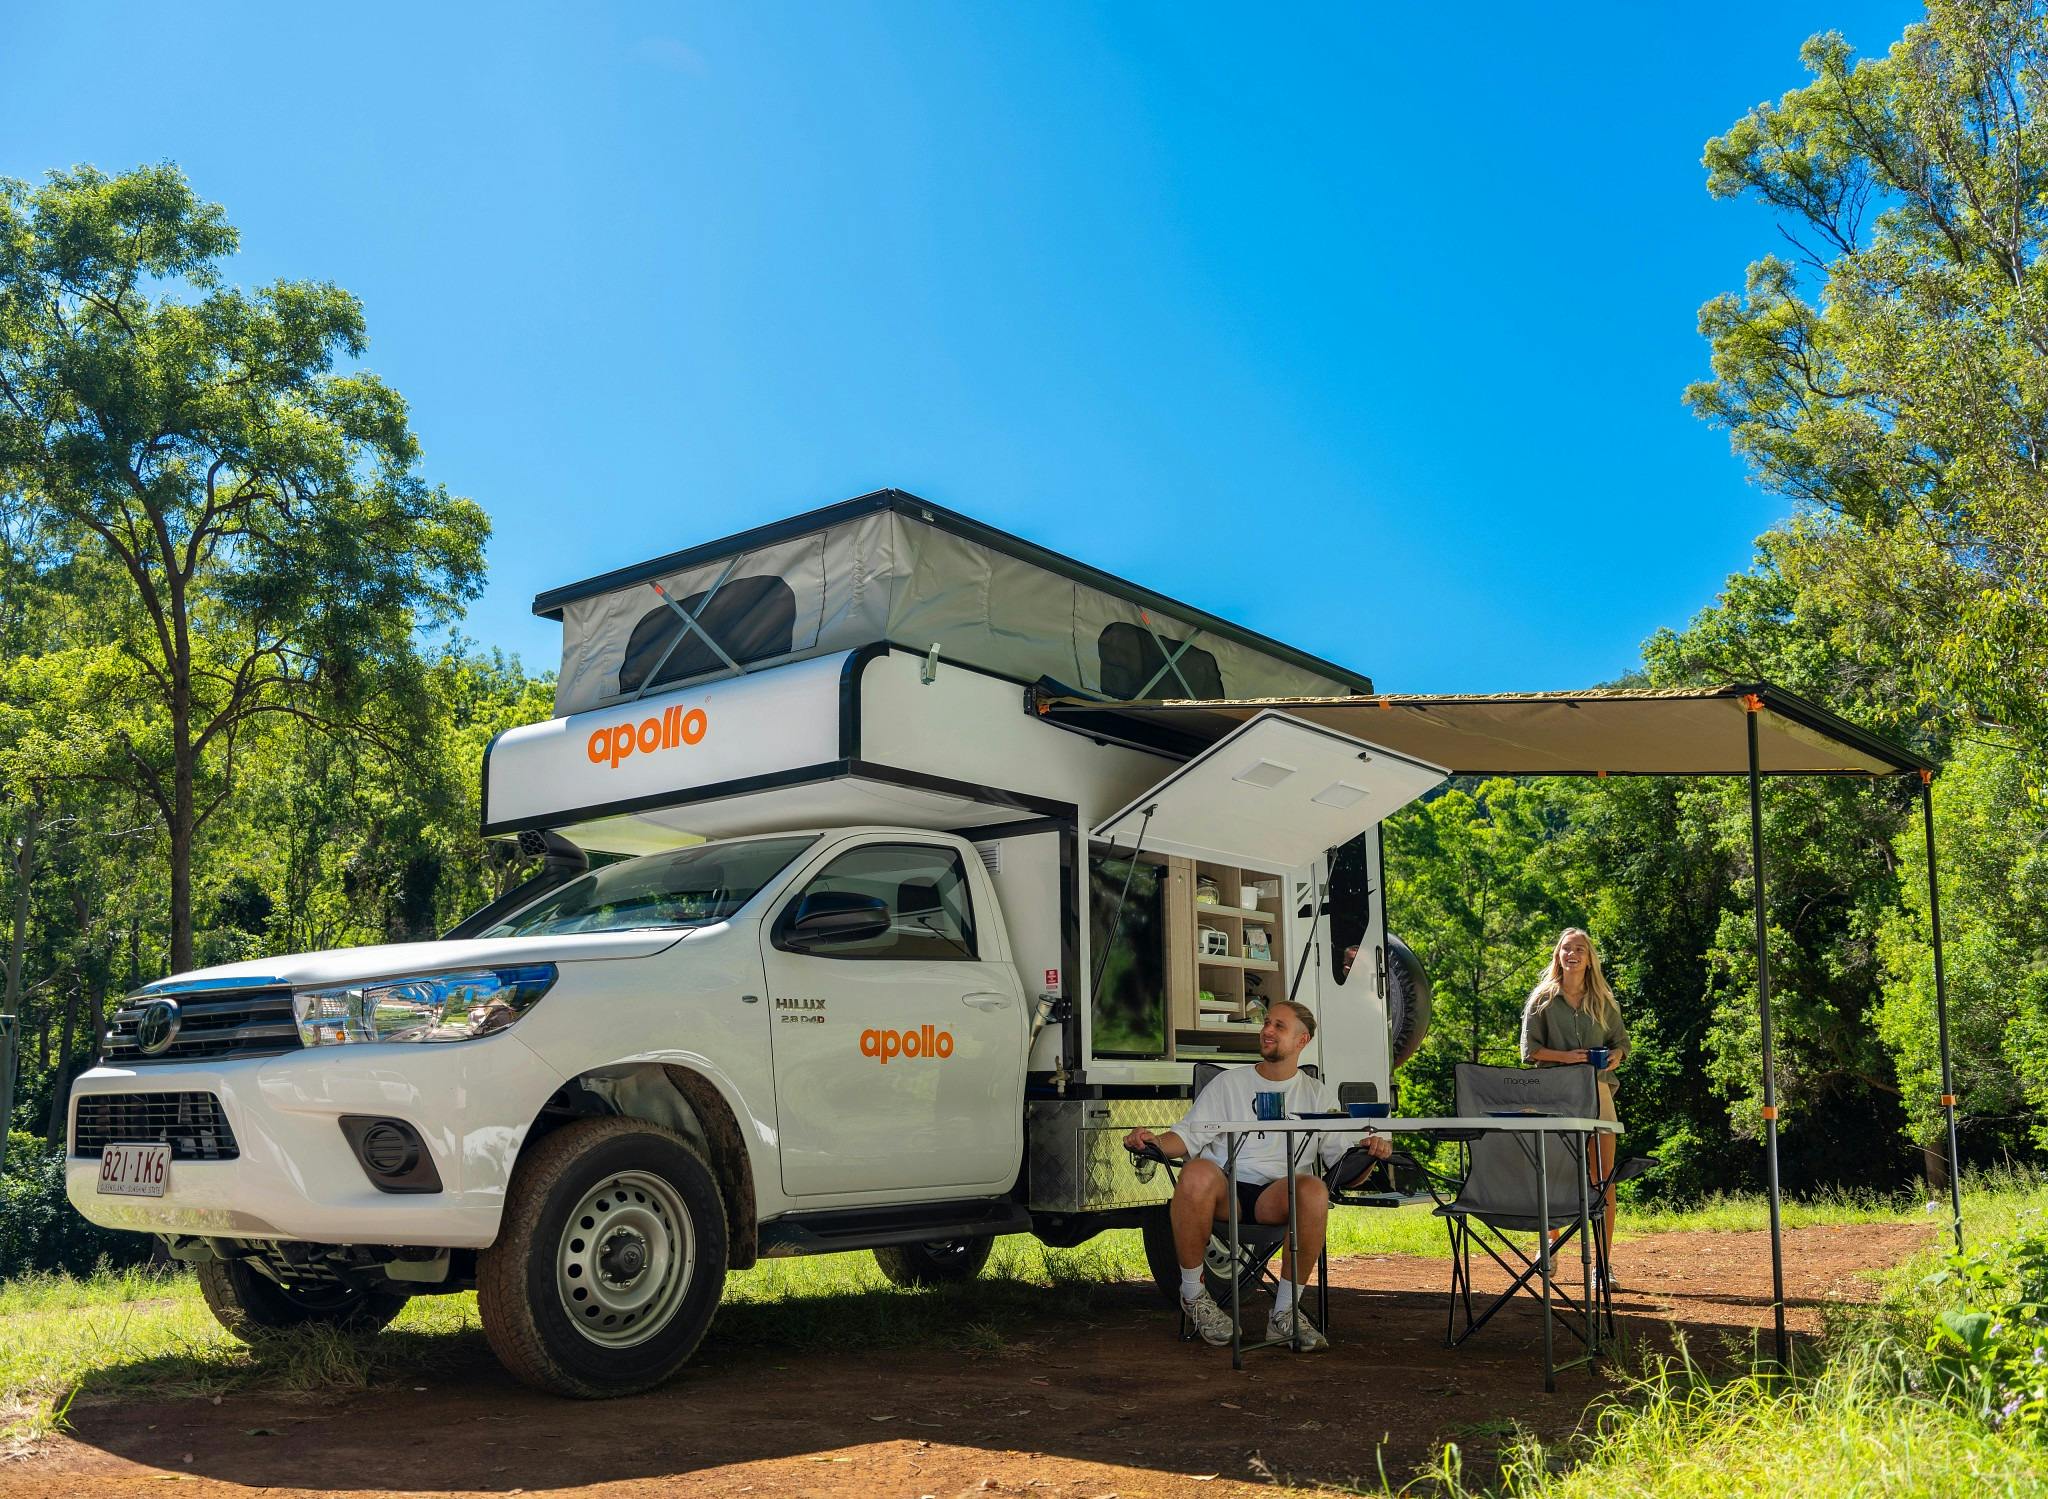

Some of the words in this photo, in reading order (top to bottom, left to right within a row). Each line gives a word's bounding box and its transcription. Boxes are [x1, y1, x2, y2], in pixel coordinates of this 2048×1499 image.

[588, 704, 708, 769] apollo
[776, 998, 826, 1010] HILUX
[860, 1024, 954, 1065] apollo
